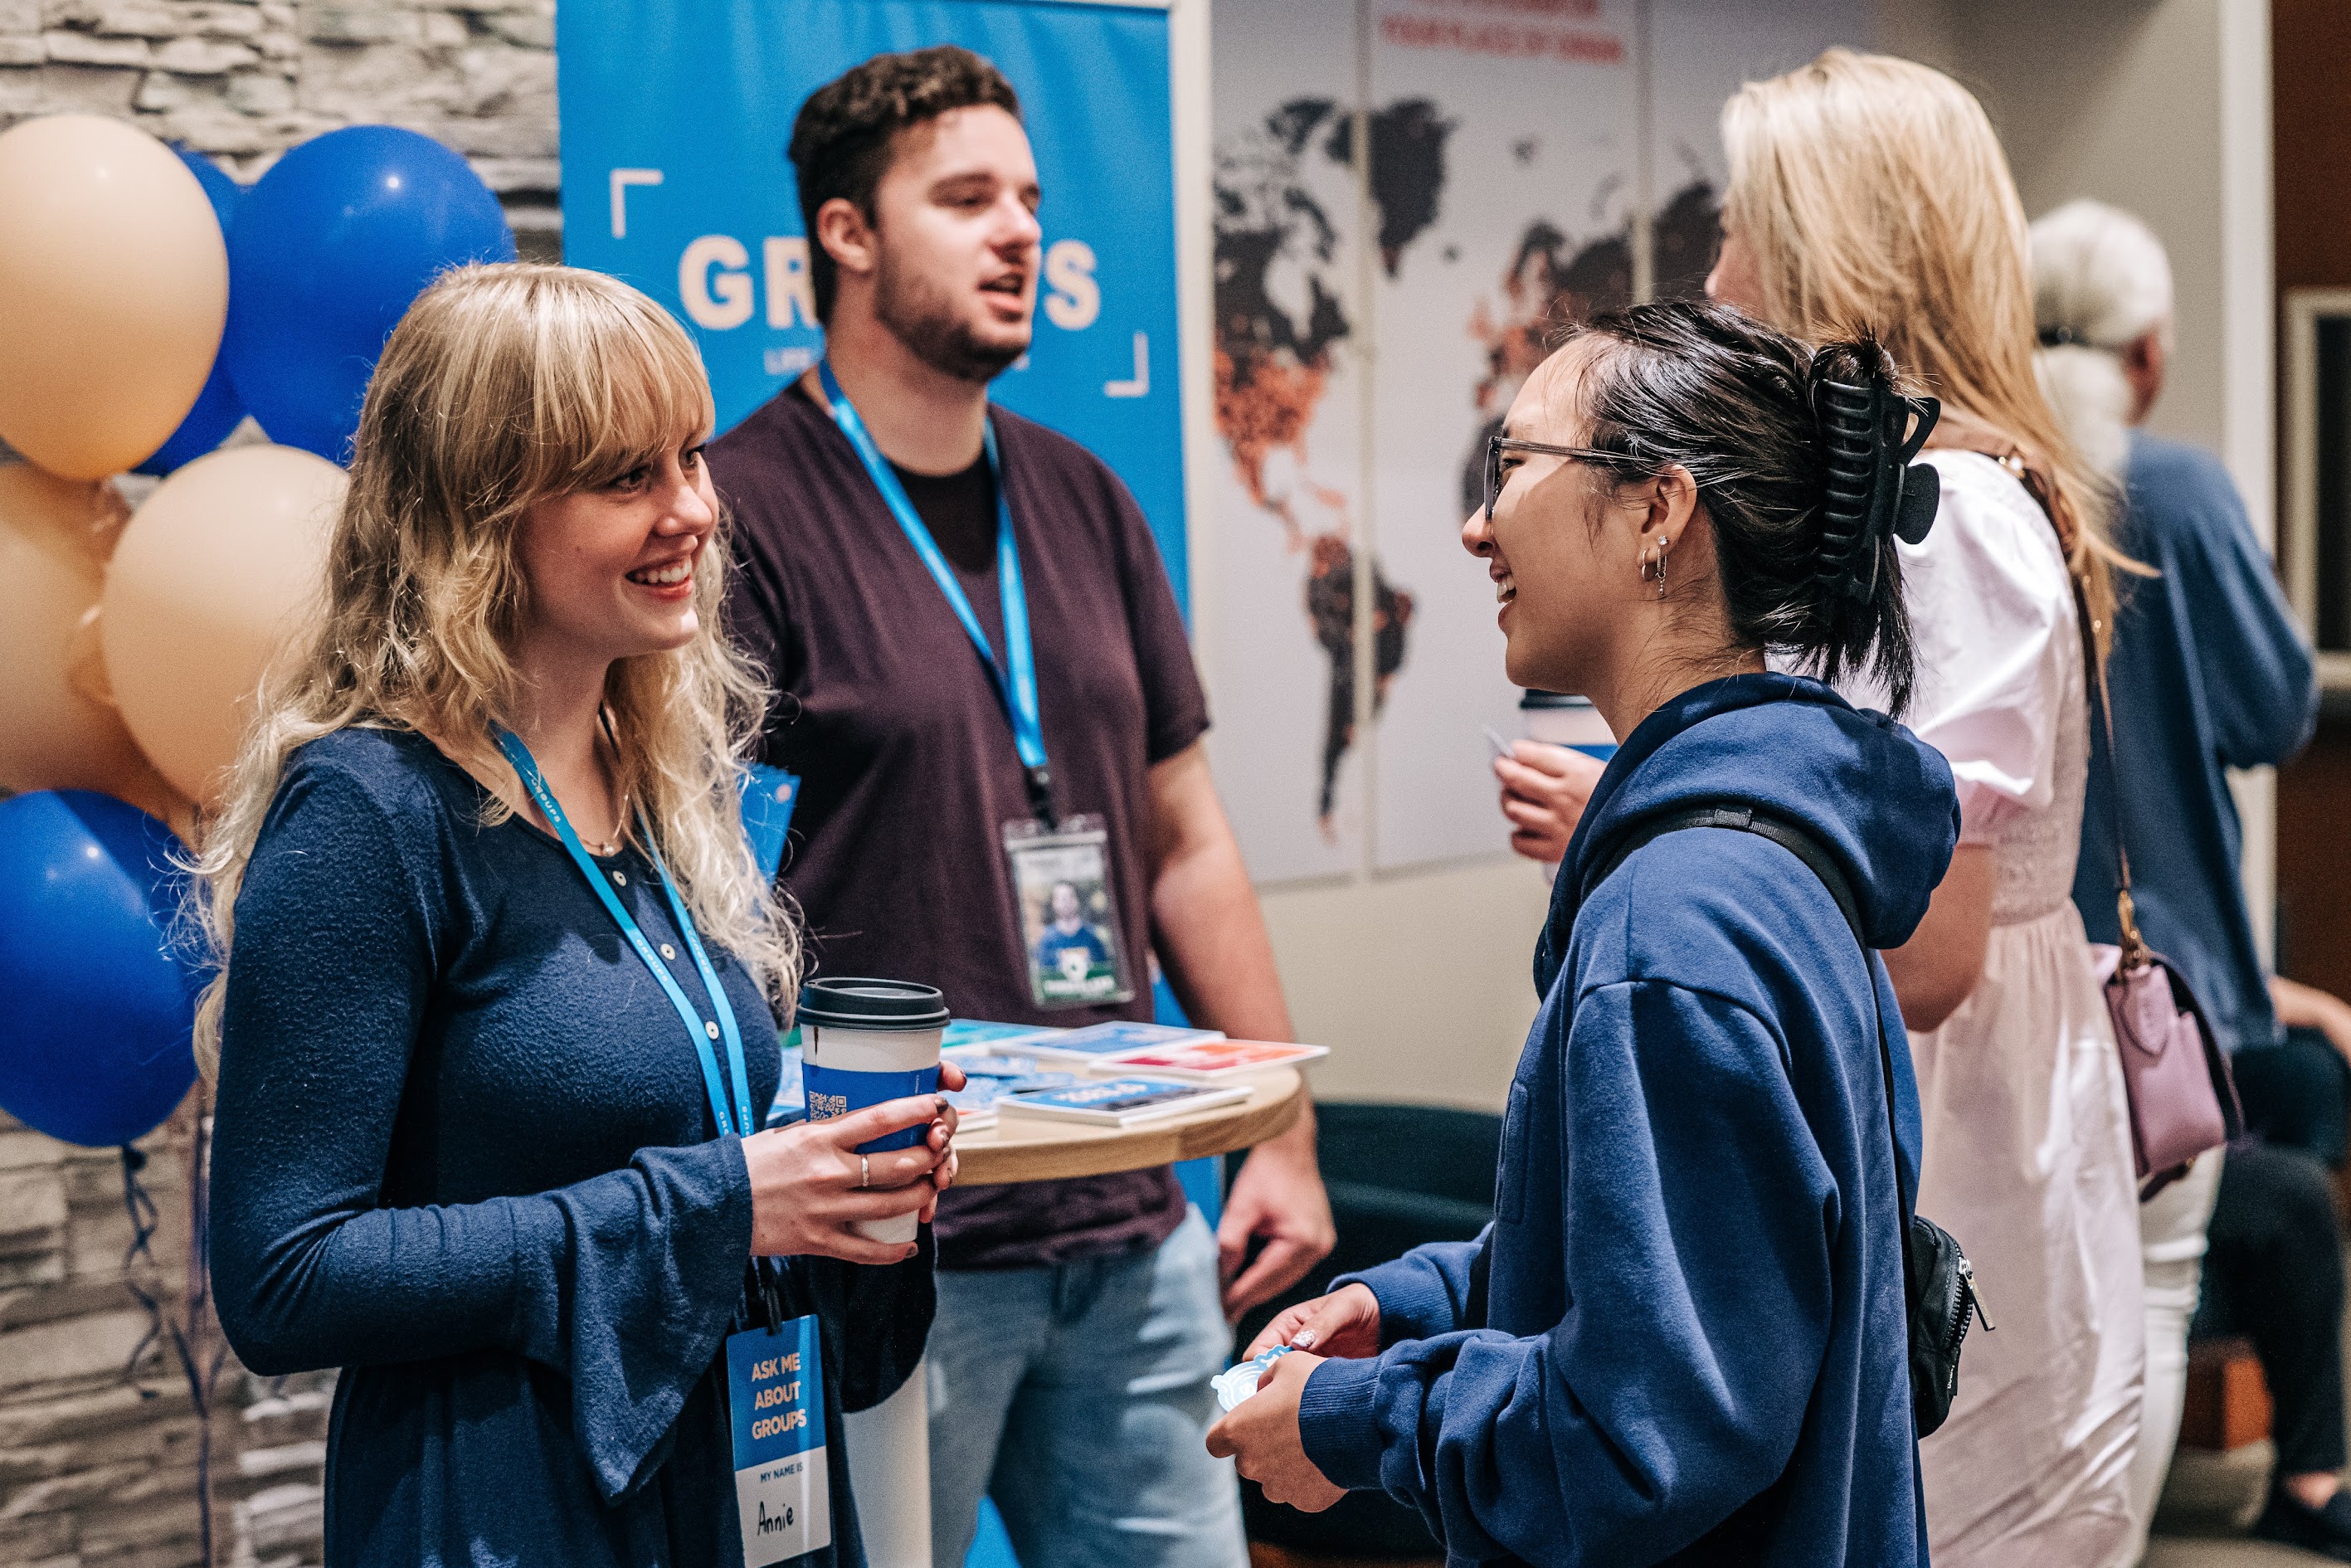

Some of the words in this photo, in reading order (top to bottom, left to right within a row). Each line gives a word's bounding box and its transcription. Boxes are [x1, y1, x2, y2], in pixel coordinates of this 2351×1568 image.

[679, 233, 1102, 331] GRS
[635, 938, 669, 982] GROUPS
[752, 1357, 780, 1382] ASK
[781, 1352, 801, 1375] ME
[754, 1381, 801, 1411] ABOUT
[752, 1408, 807, 1440] GROUPS
[760, 1472, 772, 1483] MY
[773, 1463, 796, 1479] NAME
[796, 1461, 804, 1473] IS
[757, 1500, 795, 1536] Annie
